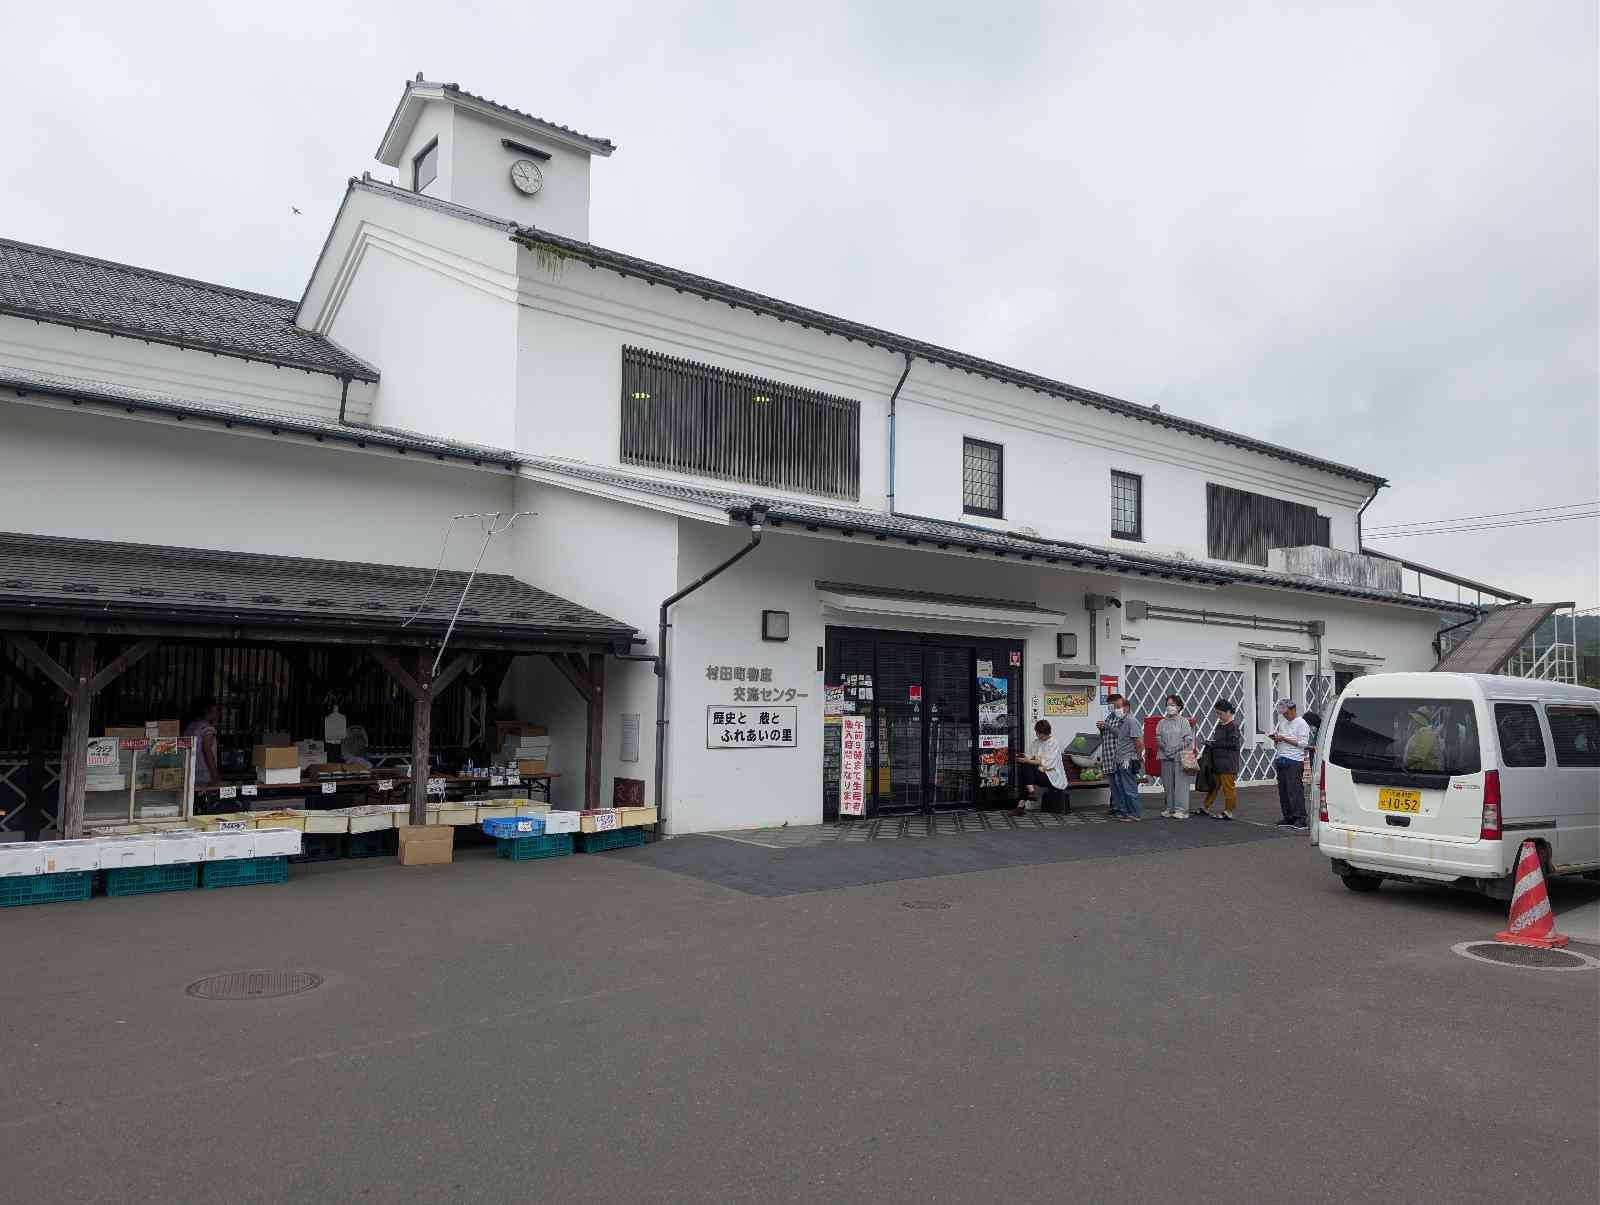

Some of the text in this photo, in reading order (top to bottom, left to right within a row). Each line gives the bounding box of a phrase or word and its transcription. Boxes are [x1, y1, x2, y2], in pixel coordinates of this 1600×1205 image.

[705, 665, 773, 682] 村田町物産
[733, 686, 809, 702] 交流センター
[713, 712, 780, 726] 歴史と 蔵と
[721, 729, 793, 743] ふれあいの里
